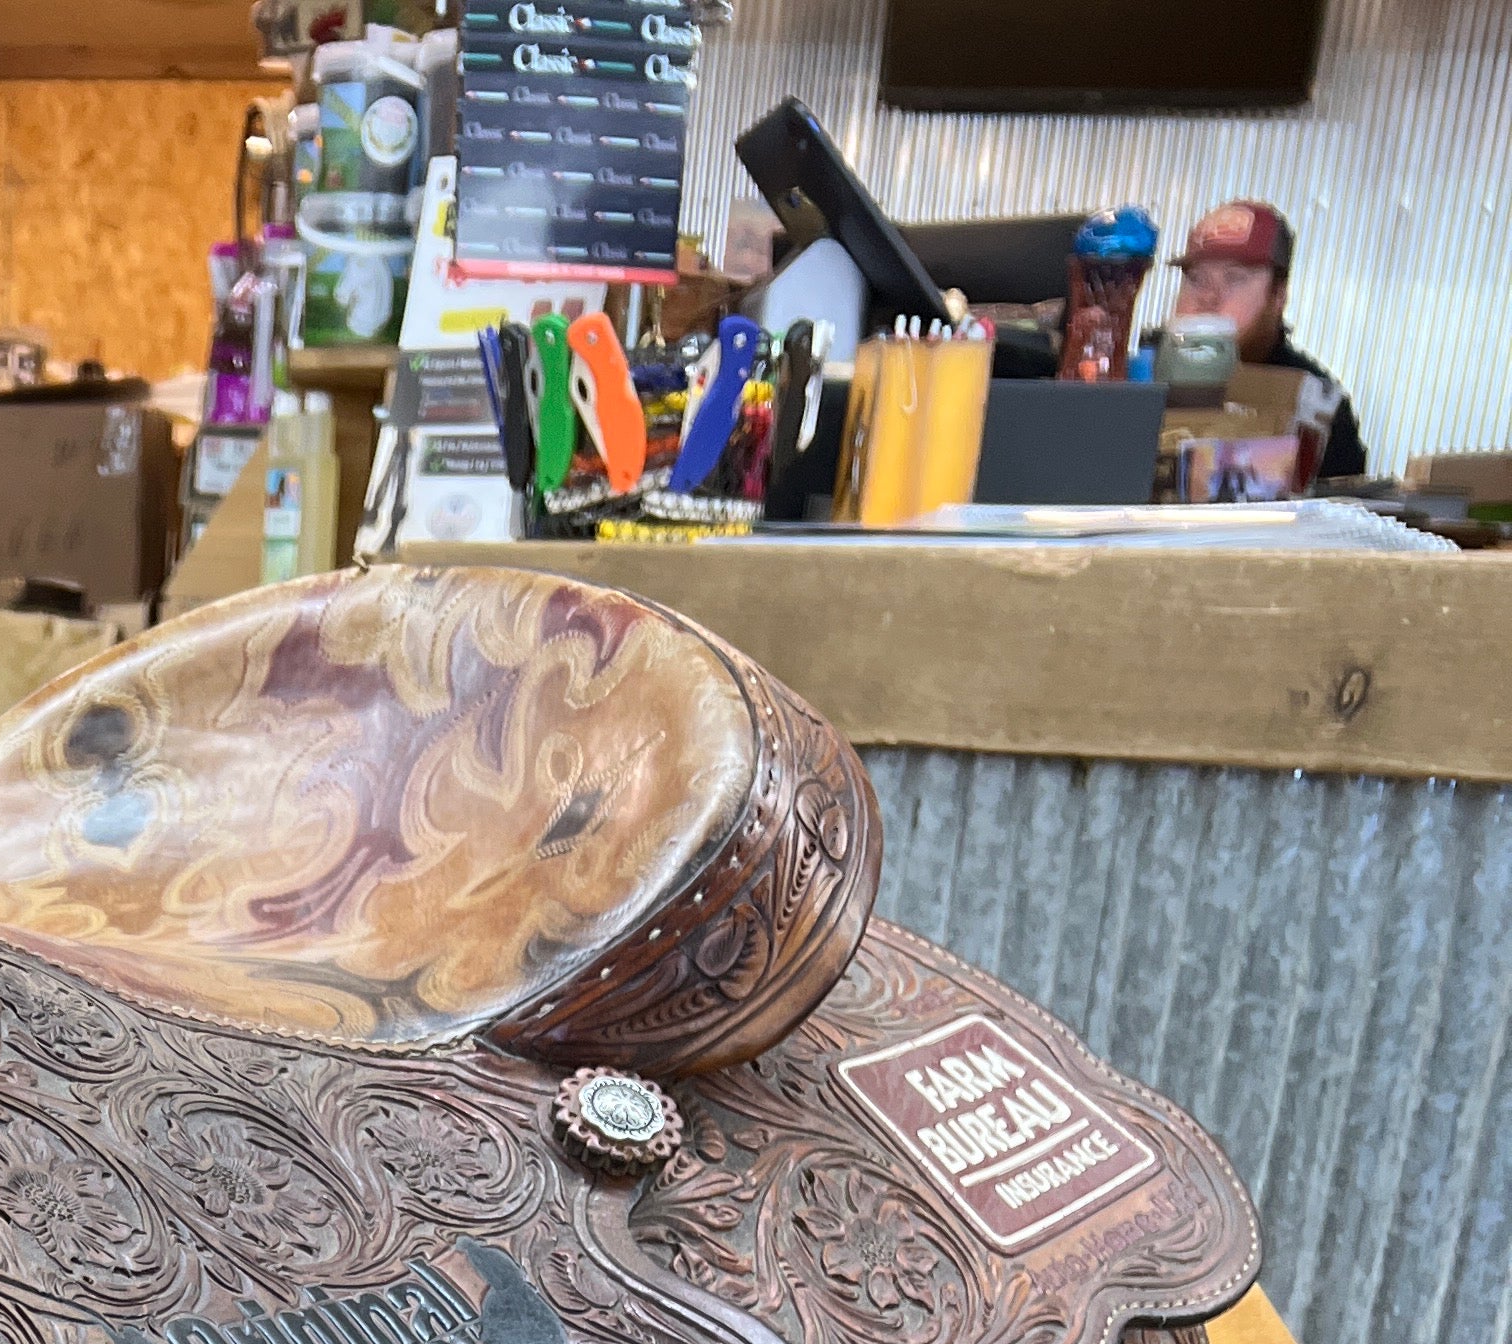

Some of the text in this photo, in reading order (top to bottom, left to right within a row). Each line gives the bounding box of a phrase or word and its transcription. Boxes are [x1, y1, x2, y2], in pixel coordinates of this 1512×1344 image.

[905, 1044, 1026, 1113] FARM
[916, 1079, 1072, 1174] BUREAU
[994, 1129, 1120, 1209] INSURANCE
